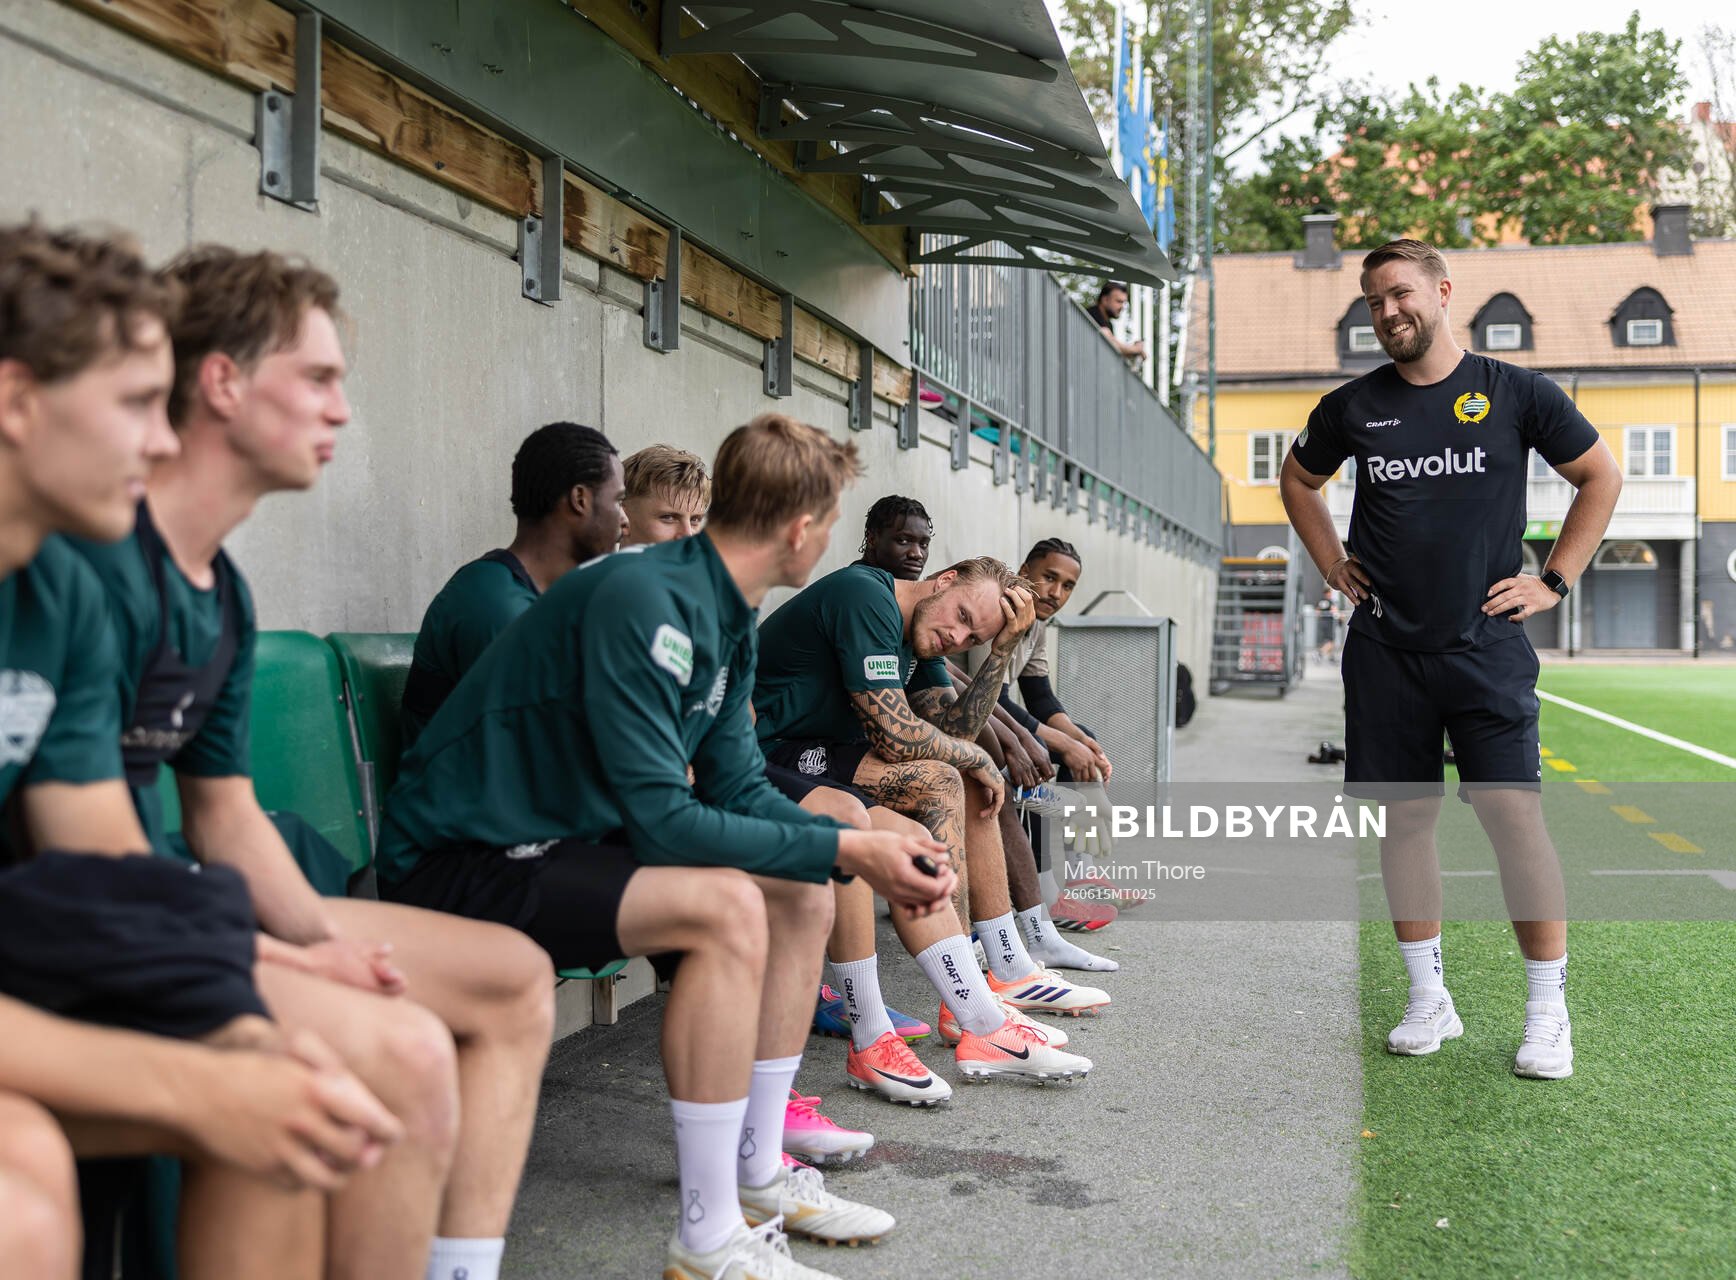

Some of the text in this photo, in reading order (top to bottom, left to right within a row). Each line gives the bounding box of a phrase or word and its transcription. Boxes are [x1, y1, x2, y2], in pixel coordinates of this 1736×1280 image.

[1365, 419, 1394, 428] CRAFT
[1367, 446, 1486, 484] Revolut
[998, 929, 1012, 951] CRAFT
[942, 954, 963, 984] CRAFT
[844, 977, 857, 1010] CRAFT
